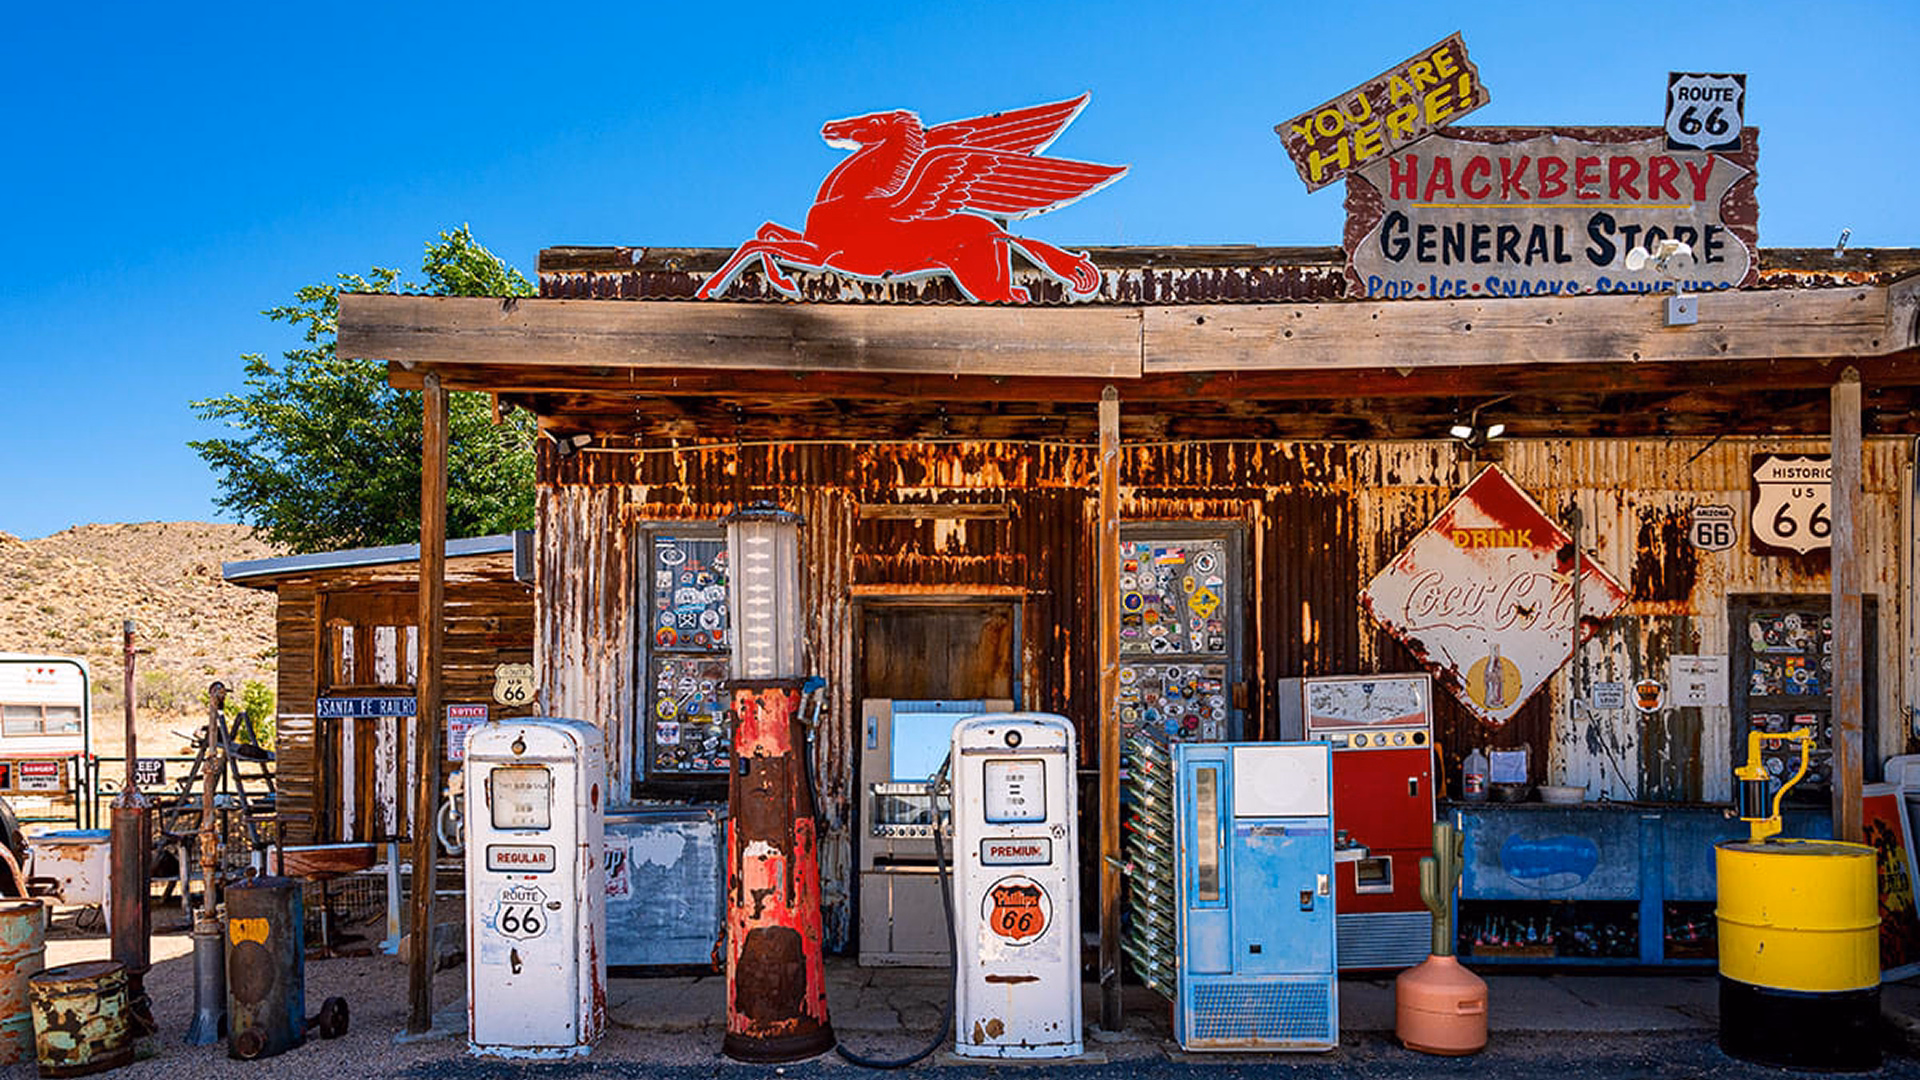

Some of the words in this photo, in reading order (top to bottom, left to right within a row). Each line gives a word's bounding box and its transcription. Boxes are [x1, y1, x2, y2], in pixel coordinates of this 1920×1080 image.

[1292, 93, 1373, 146] YOU
[1388, 47, 1460, 105] ARE
[1678, 86, 1733, 102] ROUTE
[1309, 73, 1473, 182] HERE!
[1679, 105, 1730, 136] 66
[1389, 153, 1716, 202] HACKBERRY
[1380, 210, 1573, 266] GENERAL
[1772, 467, 1831, 479] HISTORIC
[1792, 487, 1815, 498] US
[1696, 509, 1729, 517] ARIZONA
[1773, 502, 1831, 538] 66
[1452, 528, 1533, 548] DRINK
[1697, 522, 1729, 546] 66
[503, 686, 526, 701] 66
[322, 700, 354, 715] SANTA
[361, 700, 373, 715] FE
[380, 700, 417, 715] RAILRO
[451, 707, 485, 717] NOTICE
[138, 760, 162, 772] EEP
[497, 853, 547, 864] REGULAR
[990, 846, 1042, 857] PREMIUM
[502, 890, 539, 902] ROUTE
[502, 905, 541, 934] 66
[1002, 910, 1034, 932] 66
